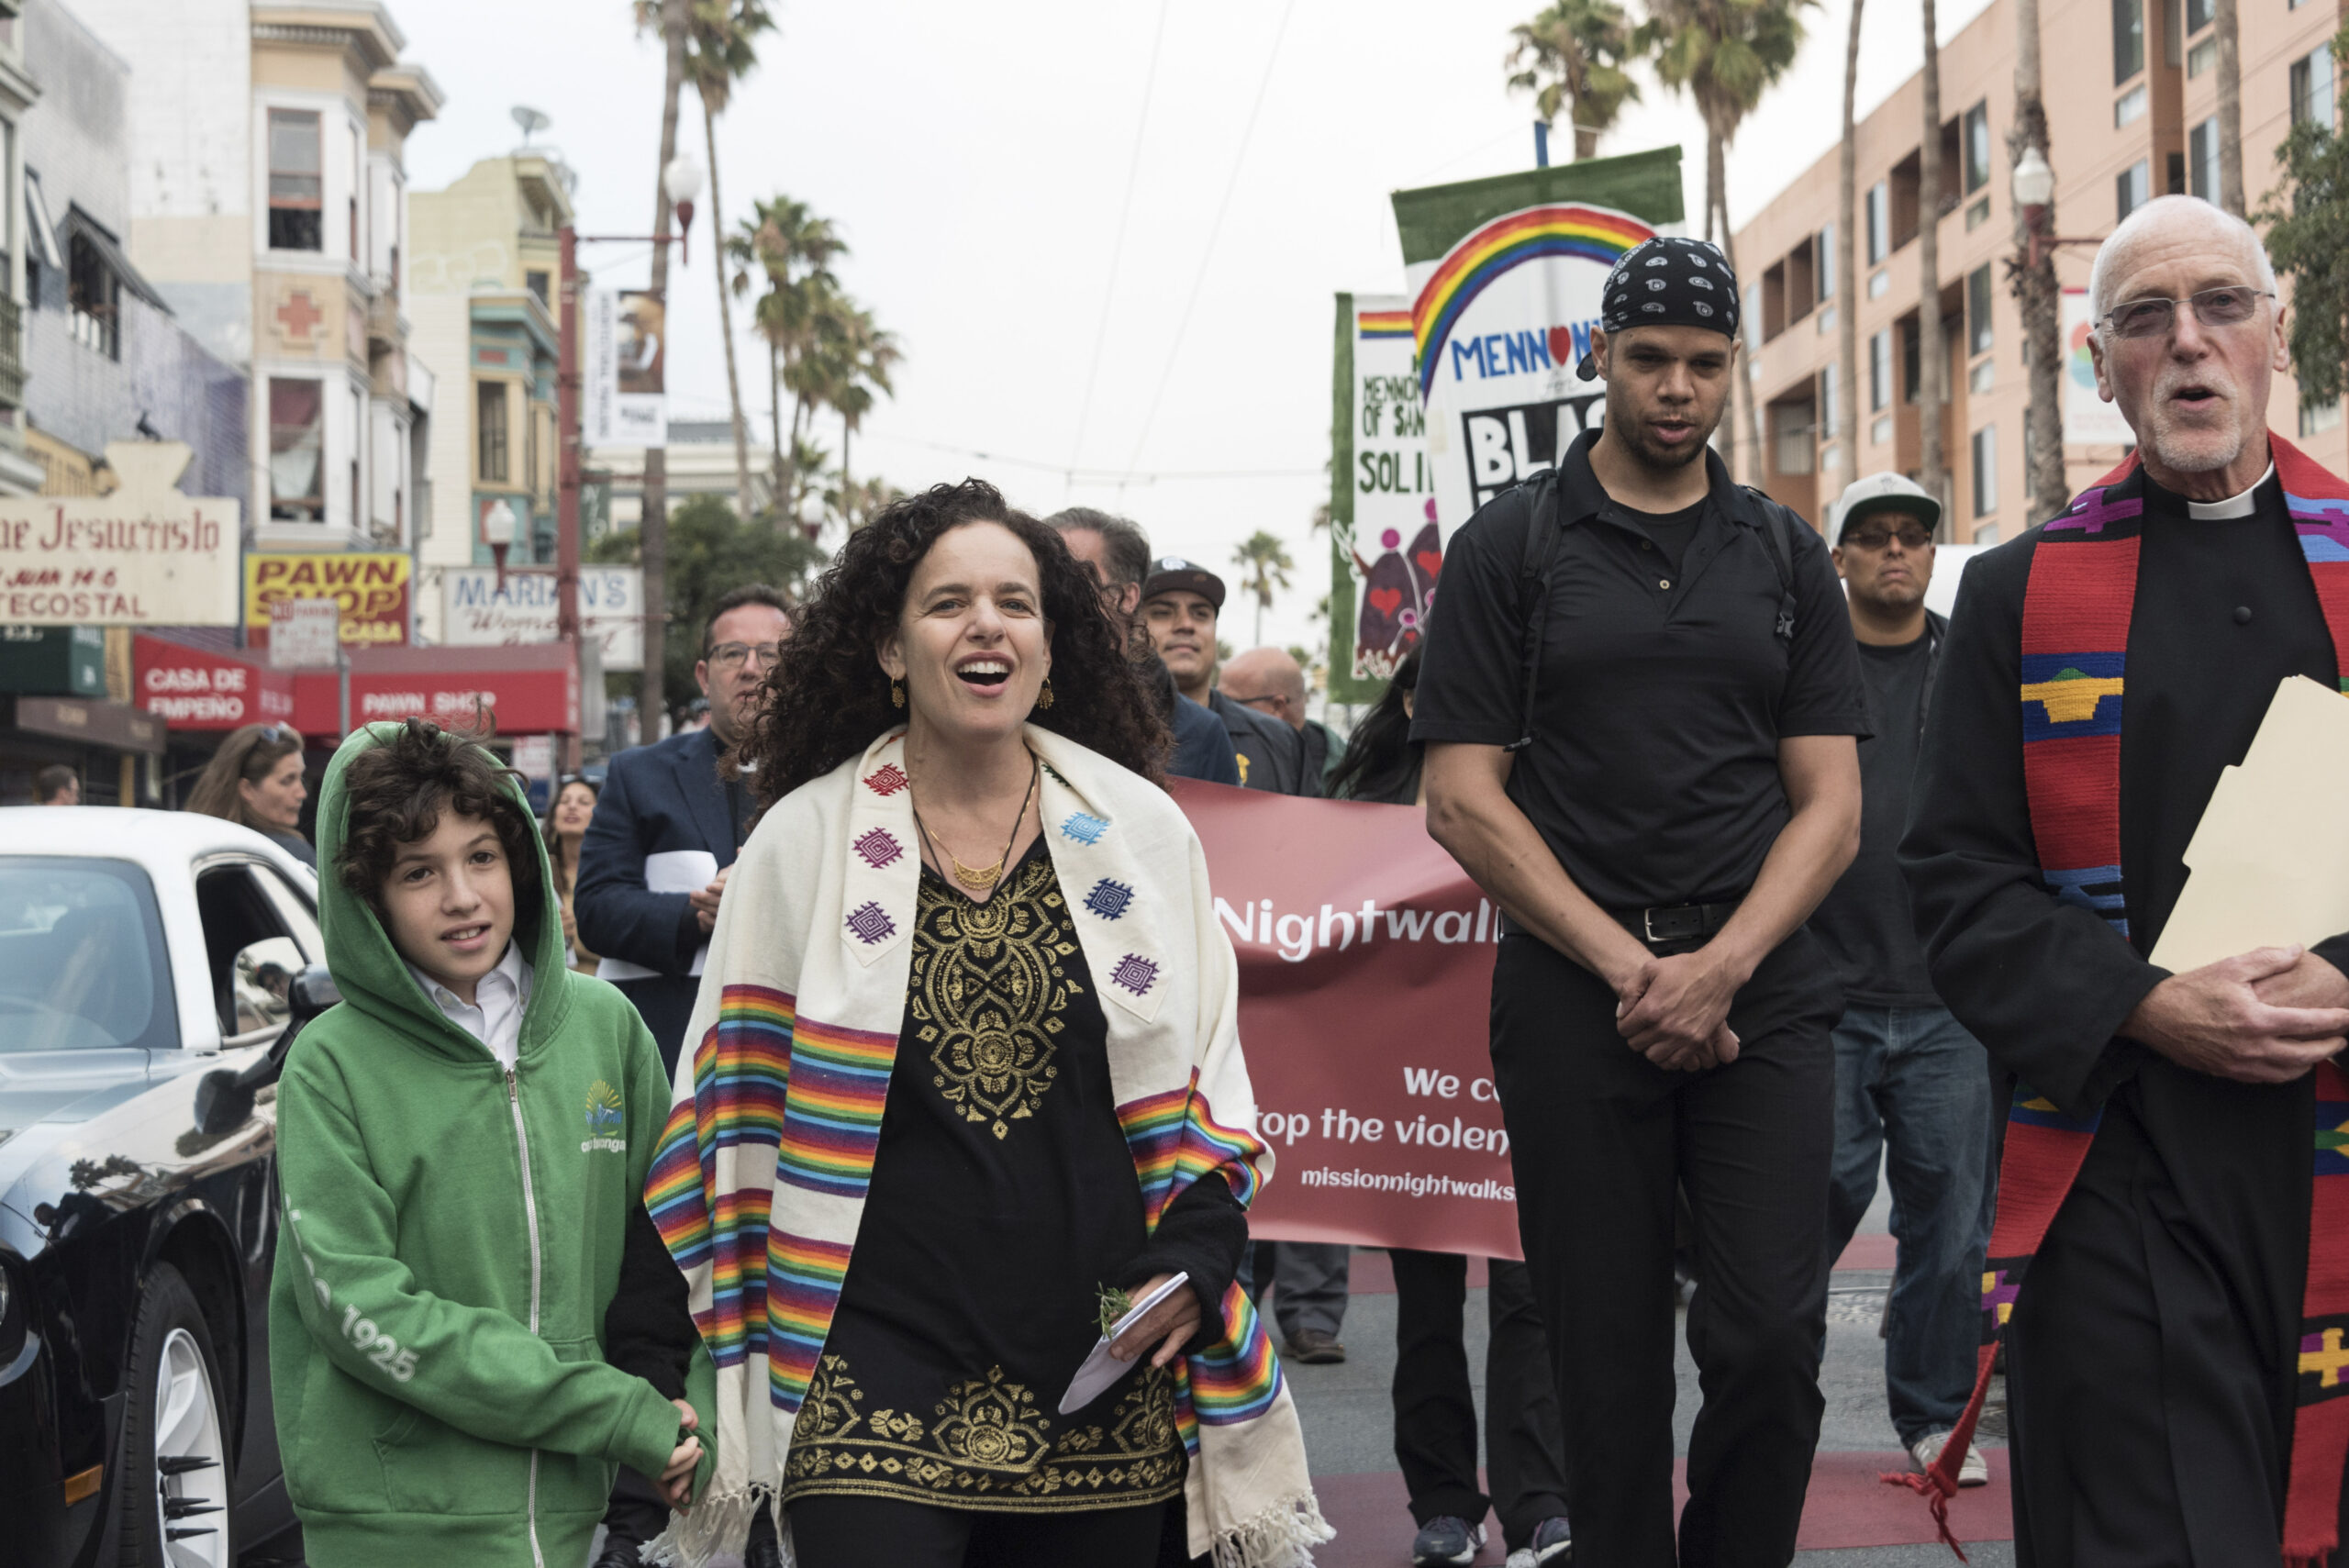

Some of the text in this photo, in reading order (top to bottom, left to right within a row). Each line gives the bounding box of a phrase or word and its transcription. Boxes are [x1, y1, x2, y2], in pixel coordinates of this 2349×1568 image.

[1364, 404, 1383, 437] OF
[1359, 450, 1434, 494] SOLI
[256, 562, 398, 586] PAWN
[256, 587, 398, 615] SOP
[145, 668, 246, 692] CASA DE
[148, 692, 244, 720] EMPEÑO
[362, 692, 496, 714] PAWN SHOP
[1213, 897, 1501, 962] Nightwal
[1403, 1066, 1460, 1098] We
[1319, 1107, 1385, 1144] the
[341, 1303, 421, 1383] 1925
